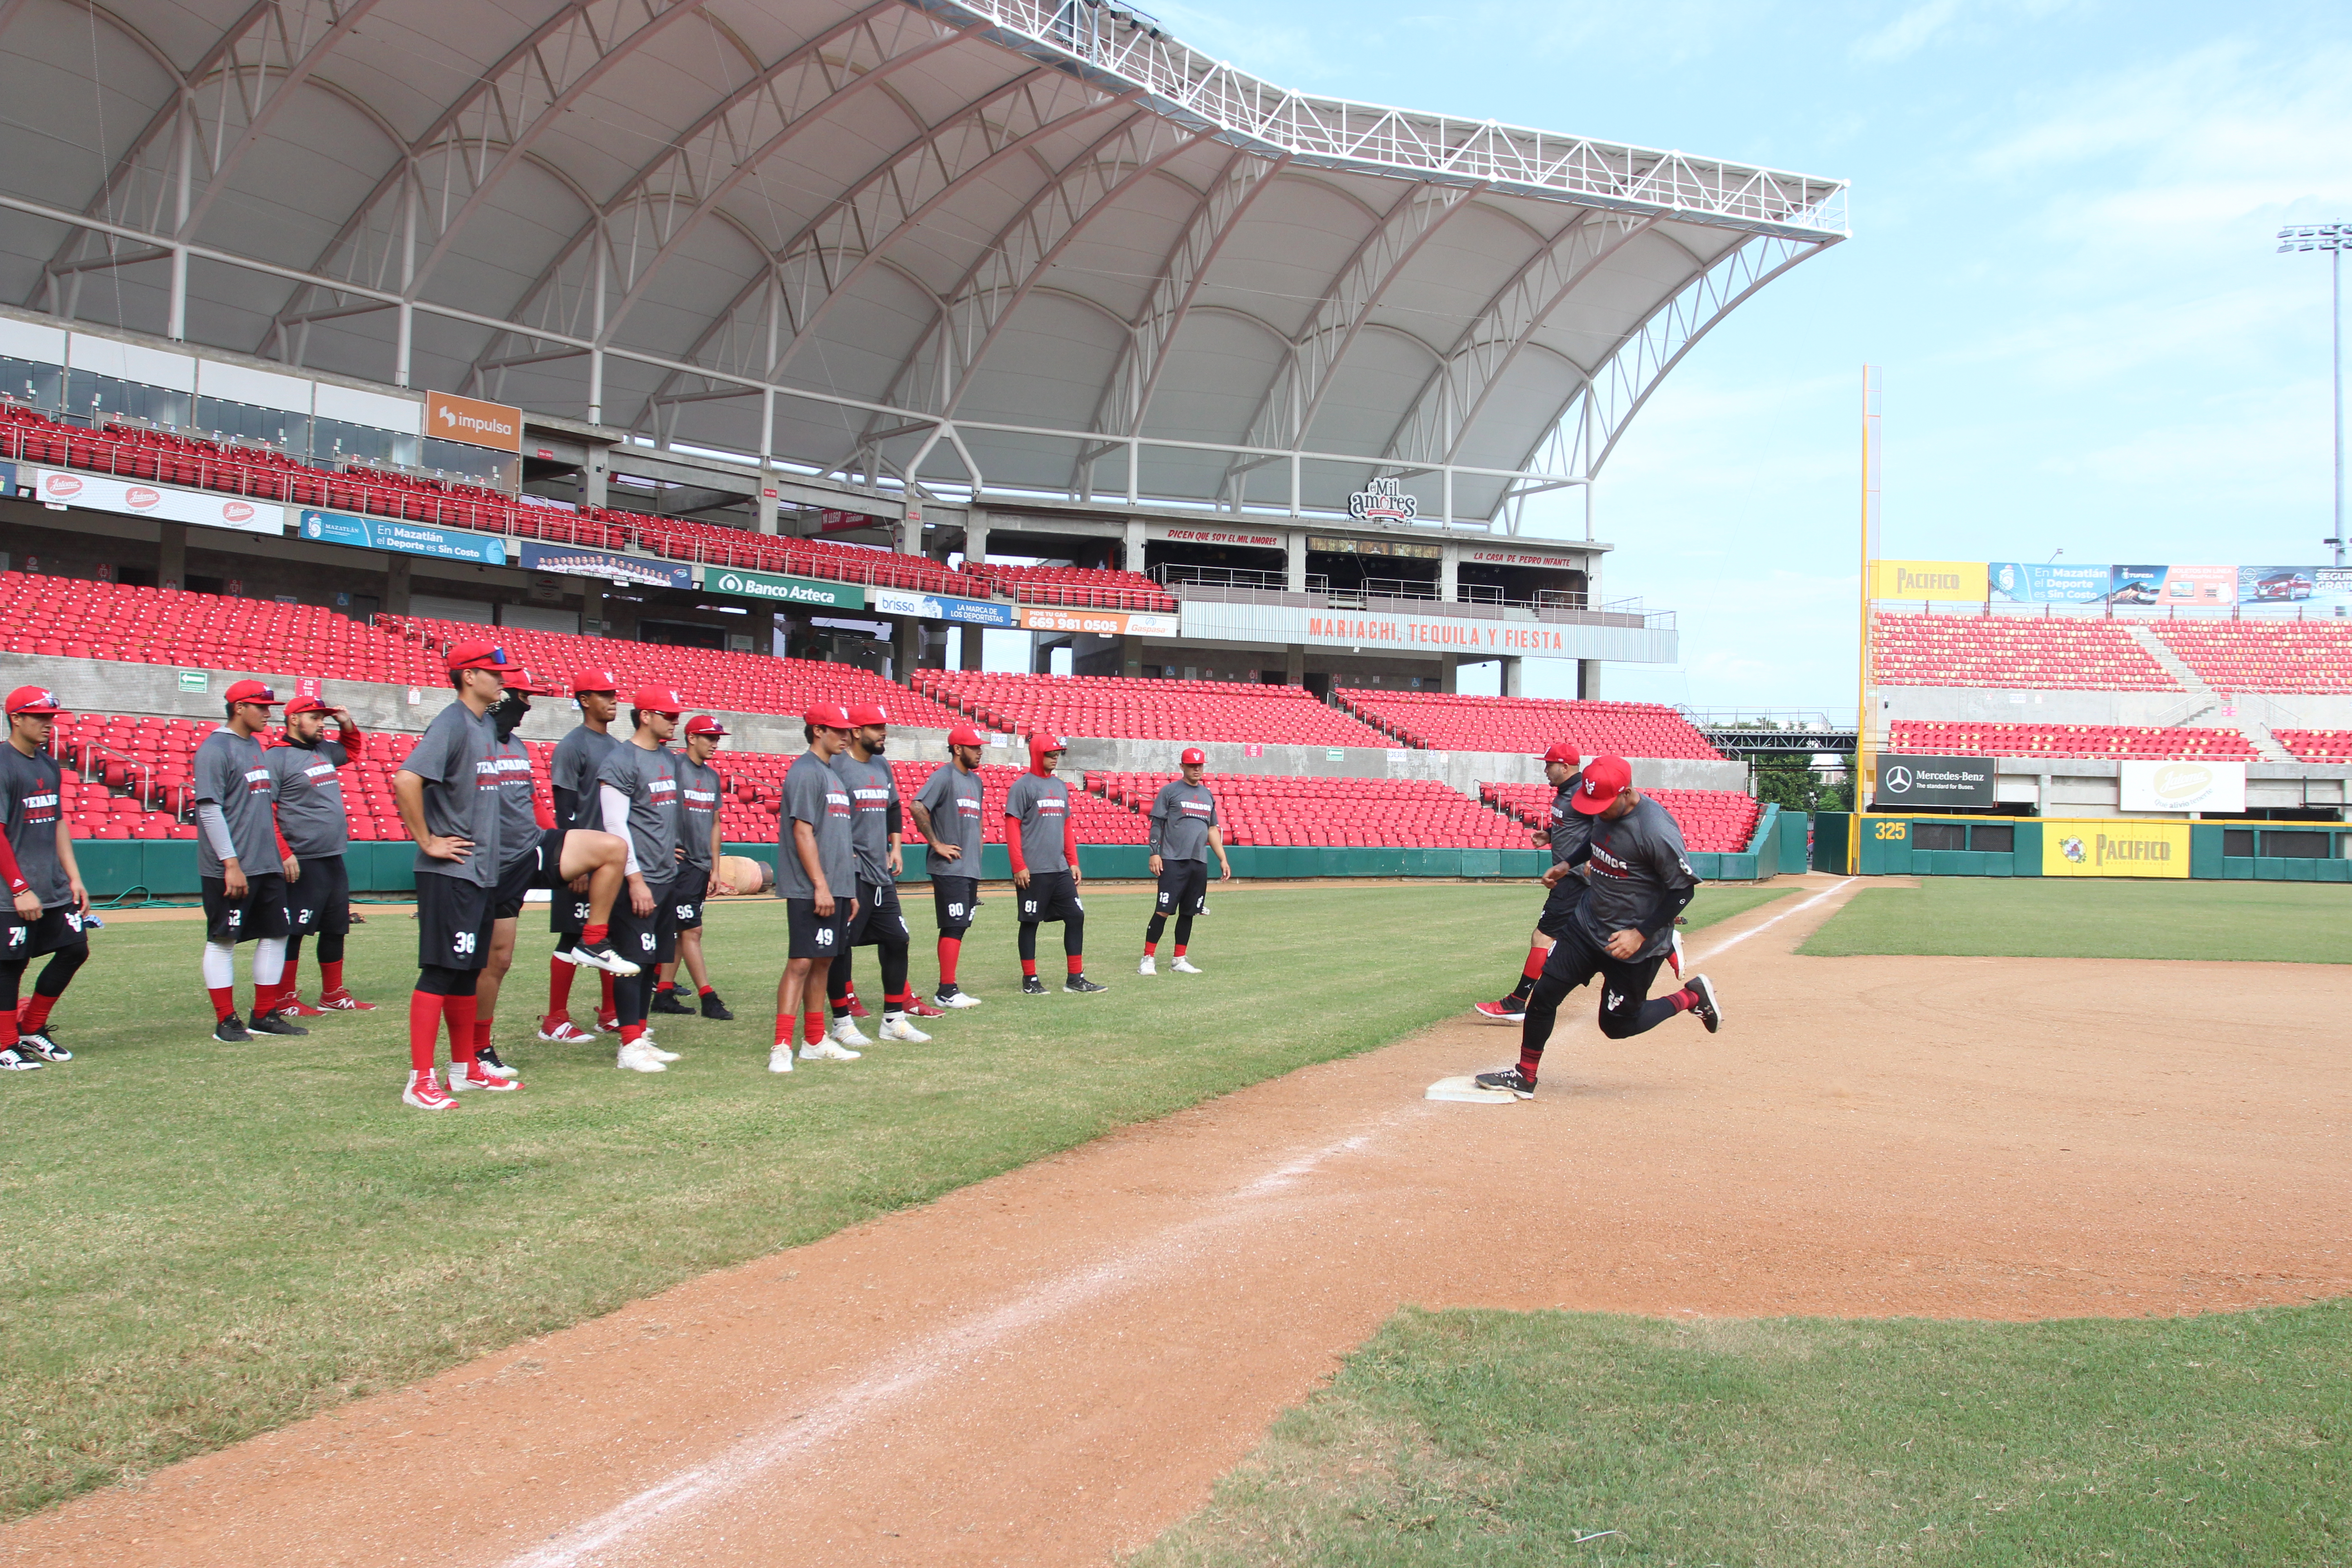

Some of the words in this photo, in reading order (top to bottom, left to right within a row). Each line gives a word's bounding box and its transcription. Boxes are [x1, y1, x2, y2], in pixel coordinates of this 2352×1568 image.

[458, 412, 511, 435] impulsa
[49, 478, 80, 491] Jaloma
[1376, 480, 1398, 496] Mil
[129, 490, 157, 504] Jaloma
[225, 505, 253, 518] Jaloma
[1352, 495, 1415, 517] amores
[325, 524, 359, 533] MAZATLÁN
[377, 525, 391, 536] En
[394, 527, 443, 543] Mazatlán
[1168, 529, 1194, 539] DICEN
[1196, 532, 1210, 541] QUE
[1212, 533, 1227, 541] SOY
[1236, 534, 1249, 544] MIL
[1250, 535, 1277, 545] AMORES
[377, 536, 385, 545] el
[387, 538, 424, 551] Deporte
[438, 544, 453, 554] Sin
[454, 547, 480, 558] Costo
[1486, 553, 1504, 561] CASA
[1519, 555, 1542, 564] PEDRO
[1543, 557, 1571, 567] INFANTE
[2035, 568, 2049, 577] En
[2053, 568, 2107, 578] Mazatlán
[1897, 568, 1960, 594] PACIFICO
[2034, 578, 2043, 588] el
[2047, 579, 2094, 589] Deporte
[745, 579, 788, 598] Banco
[789, 585, 835, 603] Azteca
[2047, 590, 2064, 598] Sin
[2067, 590, 2098, 598] Costo
[882, 596, 915, 612] brissa
[966, 605, 988, 614] MARCA
[963, 611, 1004, 623] DEPORTISTAS
[1028, 617, 1054, 627] 669
[1058, 618, 1081, 630] 981
[1083, 620, 1117, 632] 0505
[1131, 624, 1166, 634] Gaspasa
[1309, 618, 1401, 643] MARIACHI,
[1409, 623, 1479, 645] TEQUILA
[1488, 628, 1497, 646] Y
[1505, 629, 1562, 649] FIESTA
[1916, 770, 1984, 781] Mercedes-Benz
[2160, 771, 2208, 794] Jaloma
[2154, 798, 2168, 808] Qué
[2169, 800, 2190, 808] alivio
[2190, 788, 2213, 804] tenerte
[1181, 801, 1211, 811] VENADOS
[1875, 822, 1906, 840] 325
[2096, 833, 2171, 867] PACIFICO
[1159, 892, 1169, 904] 12
[676, 904, 694, 919] 96
[948, 902, 964, 917] 80
[1024, 901, 1037, 913] 81
[9, 926, 26, 946] 74
[453, 931, 475, 953] 38
[641, 932, 656, 951] 64
[815, 928, 833, 946] 49
